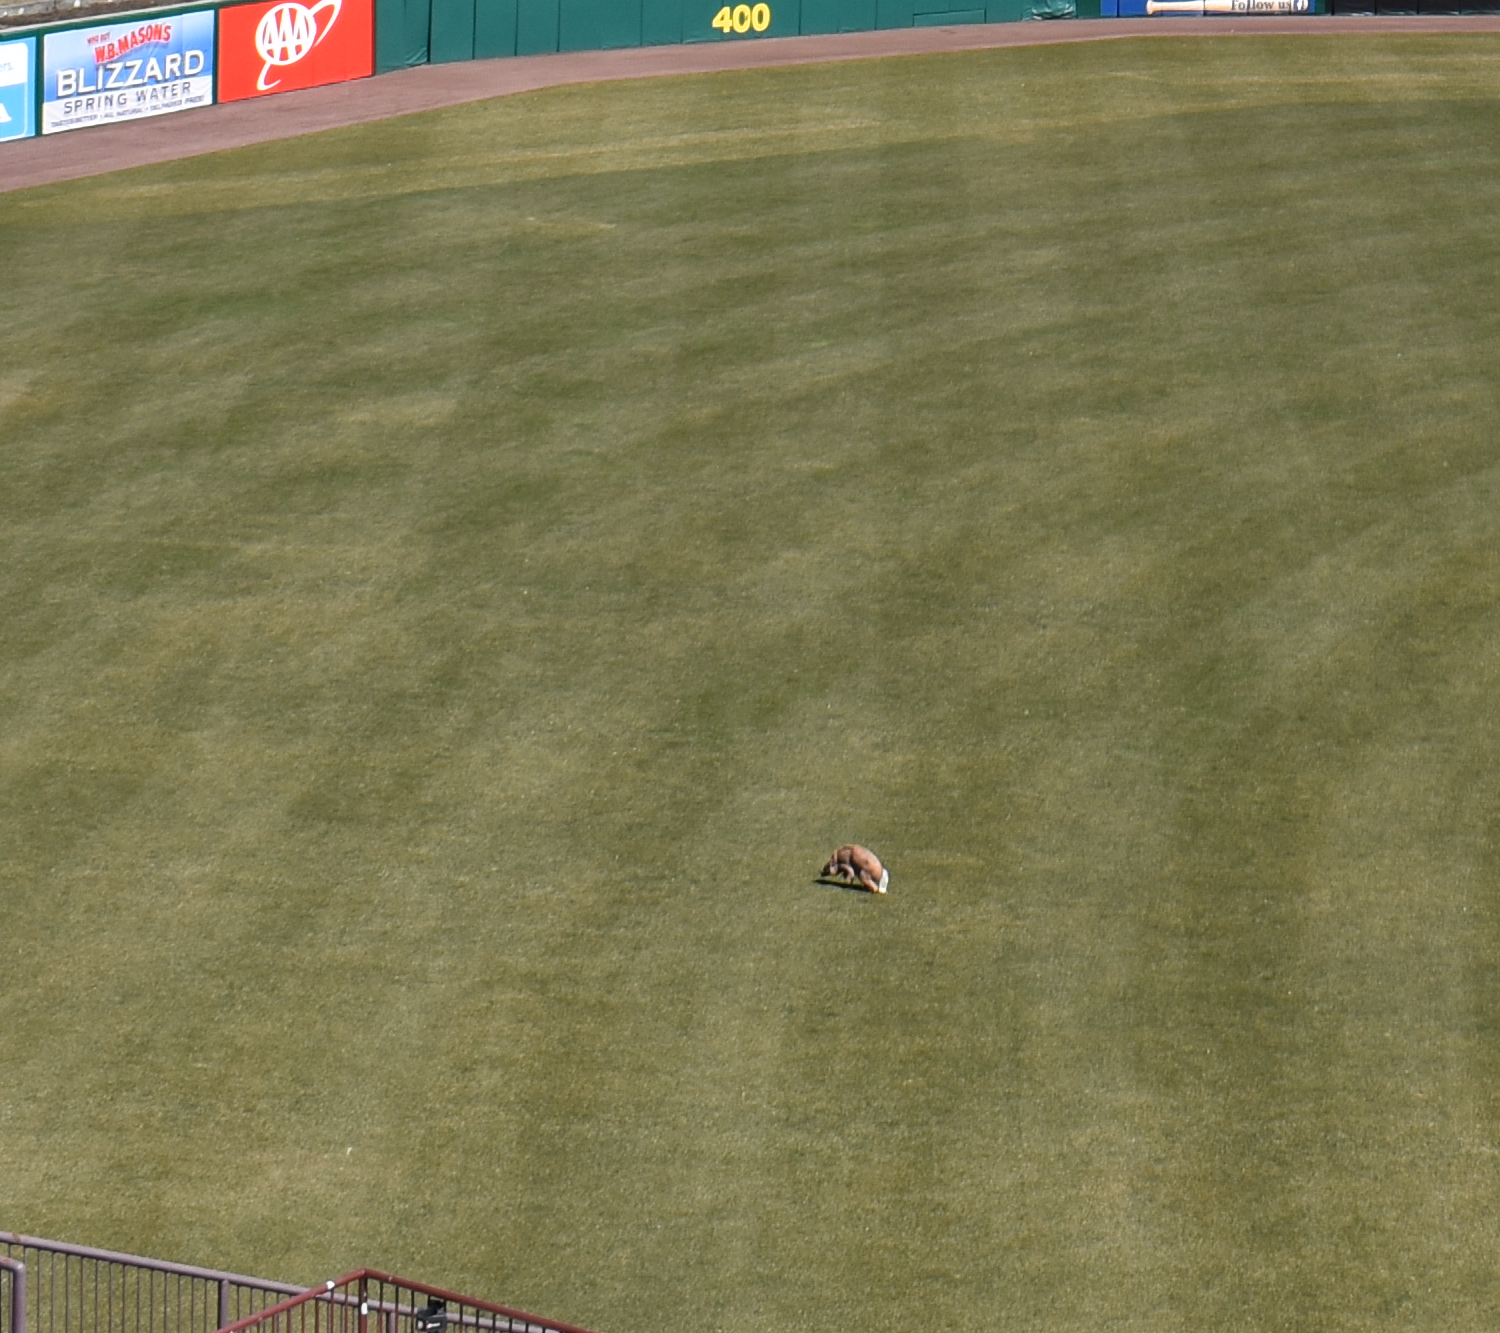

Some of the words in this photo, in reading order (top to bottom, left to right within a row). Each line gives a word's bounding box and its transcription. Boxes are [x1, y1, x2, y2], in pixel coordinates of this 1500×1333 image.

[712, 2, 770, 34] 400
[57, 50, 204, 97] BLIZZARD
[63, 93, 127, 114] SPRING
[136, 82, 191, 102] WATER
